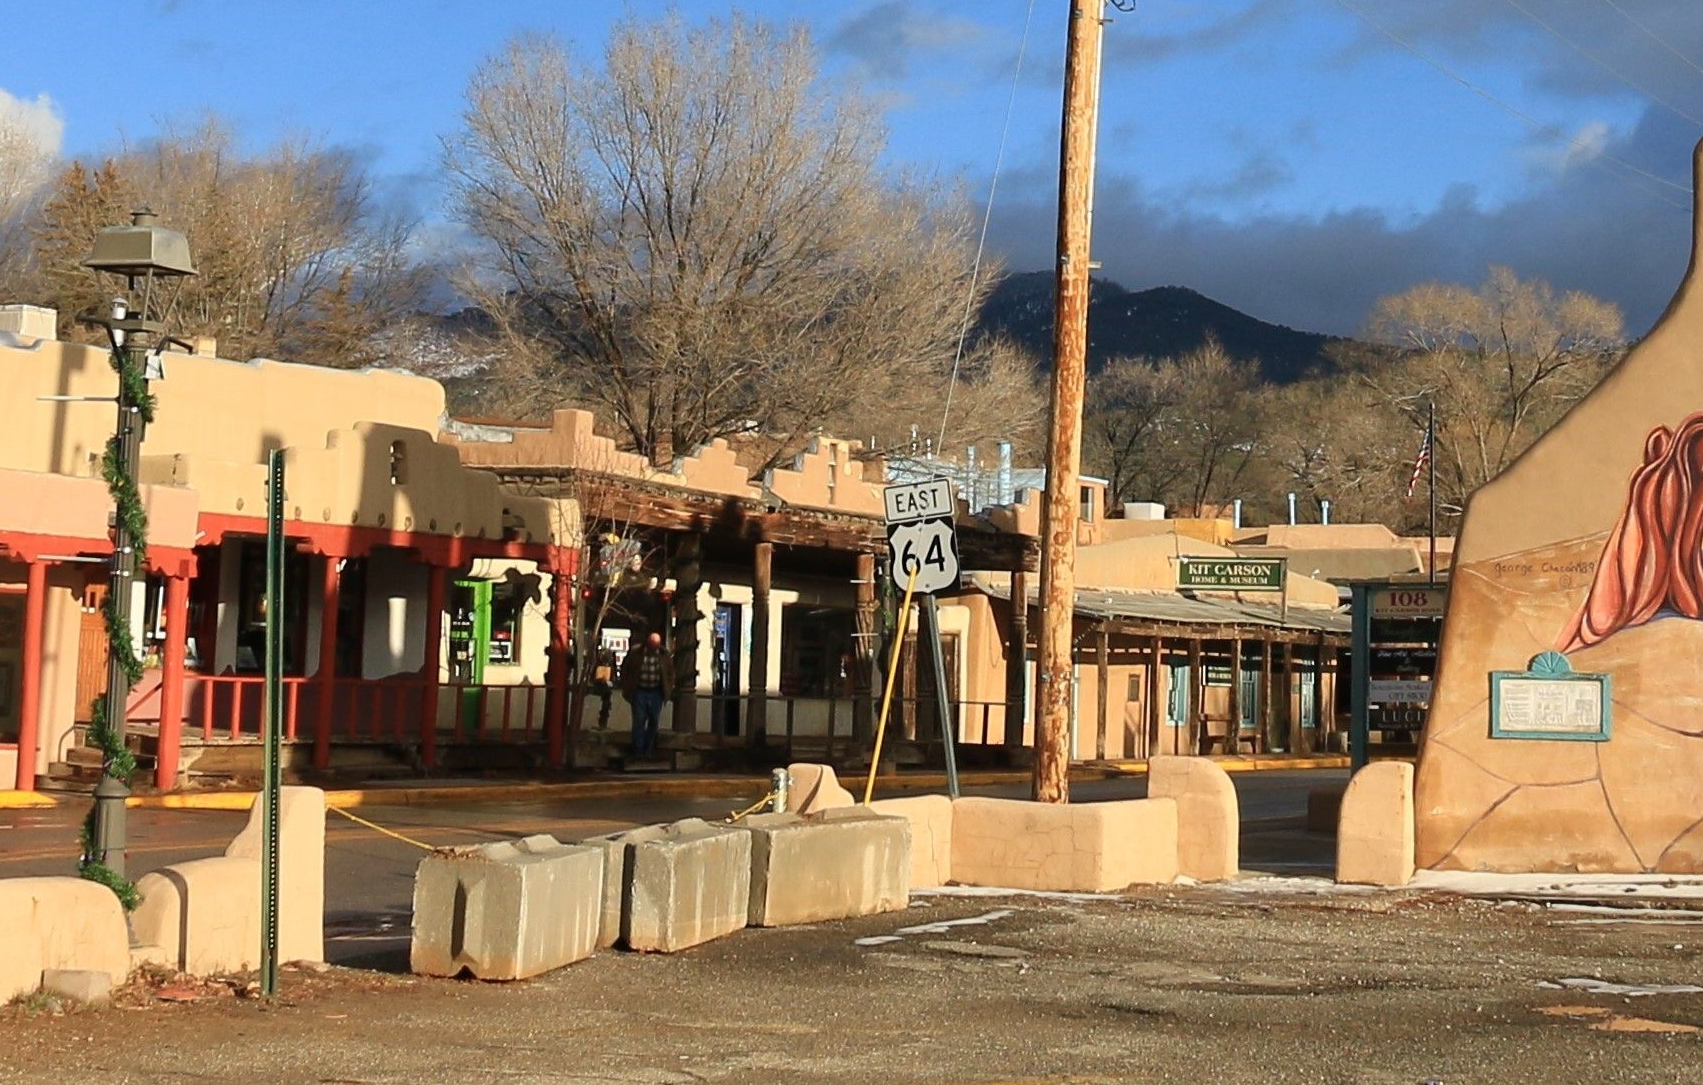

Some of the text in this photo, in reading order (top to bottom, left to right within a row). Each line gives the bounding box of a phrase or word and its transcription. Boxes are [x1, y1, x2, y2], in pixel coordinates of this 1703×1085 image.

[895, 489, 938, 513] EAST
[902, 534, 945, 576] 64
[1189, 564, 1271, 576] KIT CARSON
[1191, 576, 1268, 584] HOME & MUSEUM
[1391, 592, 1427, 606] 108
